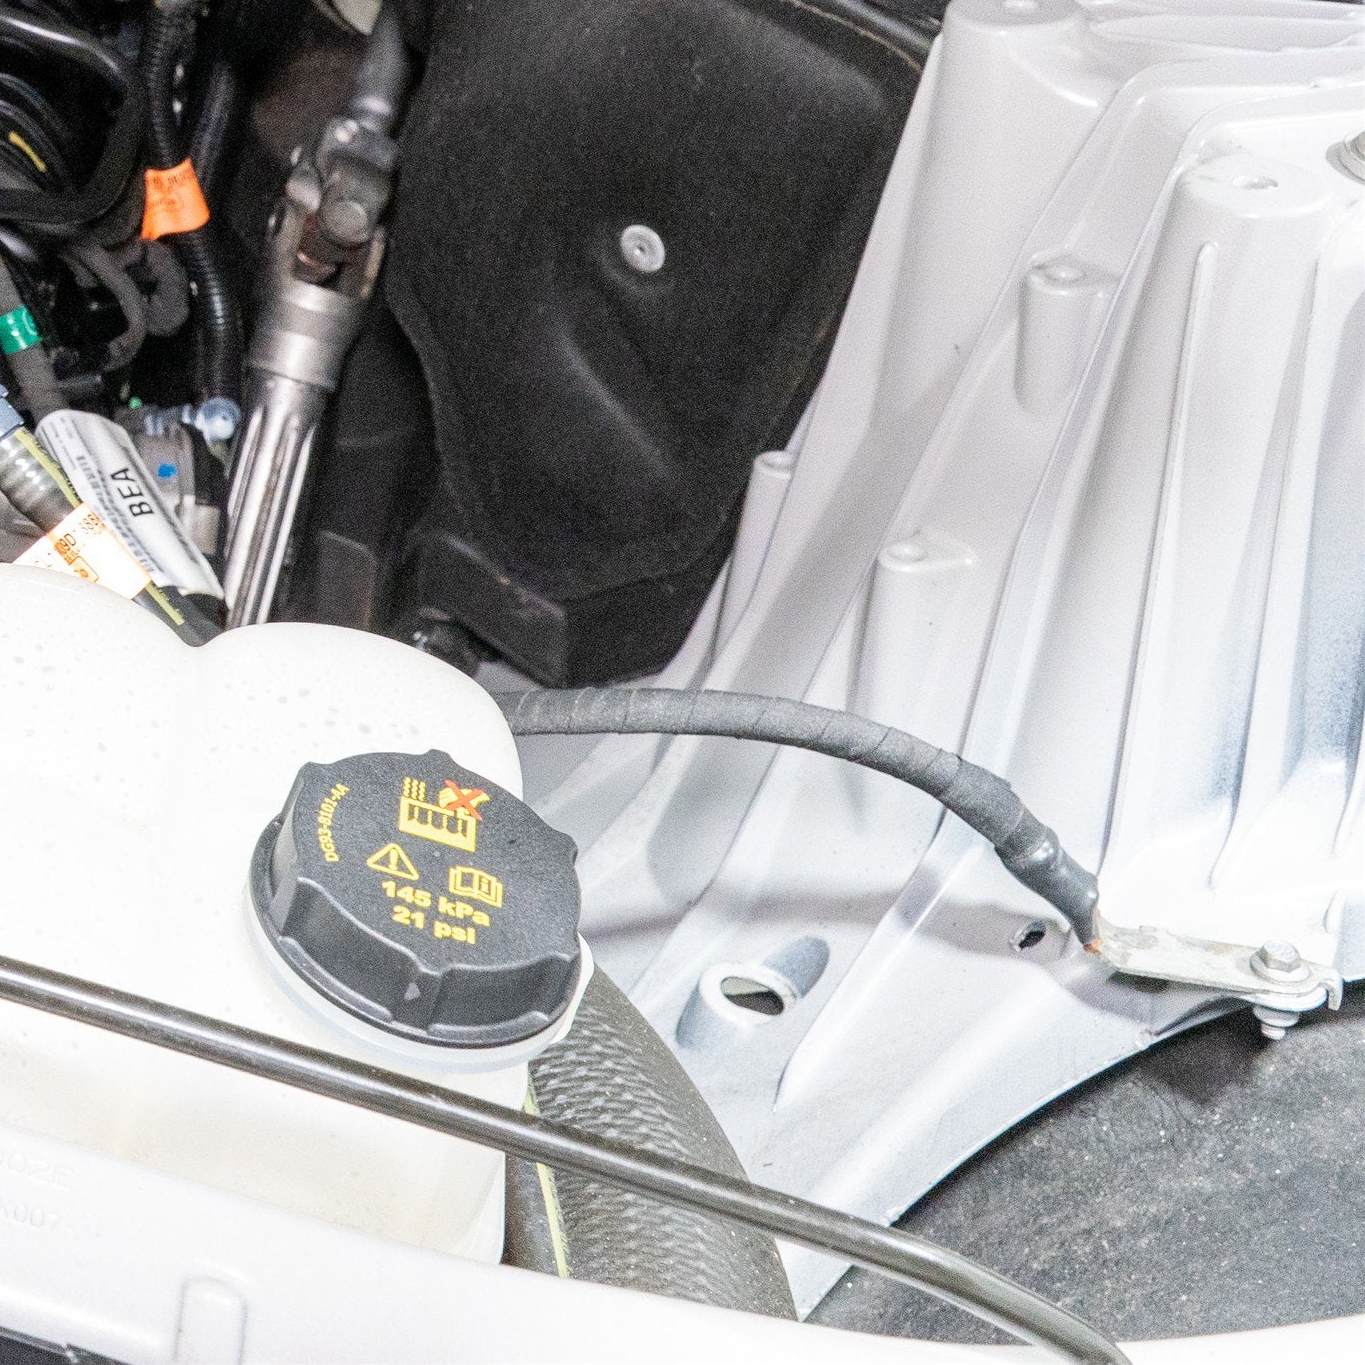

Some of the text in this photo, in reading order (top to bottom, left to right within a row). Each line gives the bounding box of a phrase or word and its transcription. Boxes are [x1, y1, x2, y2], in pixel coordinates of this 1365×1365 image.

[110, 467, 155, 518] BEA
[381, 880, 491, 927] 145 kPa
[391, 905, 477, 945] 21 psi
